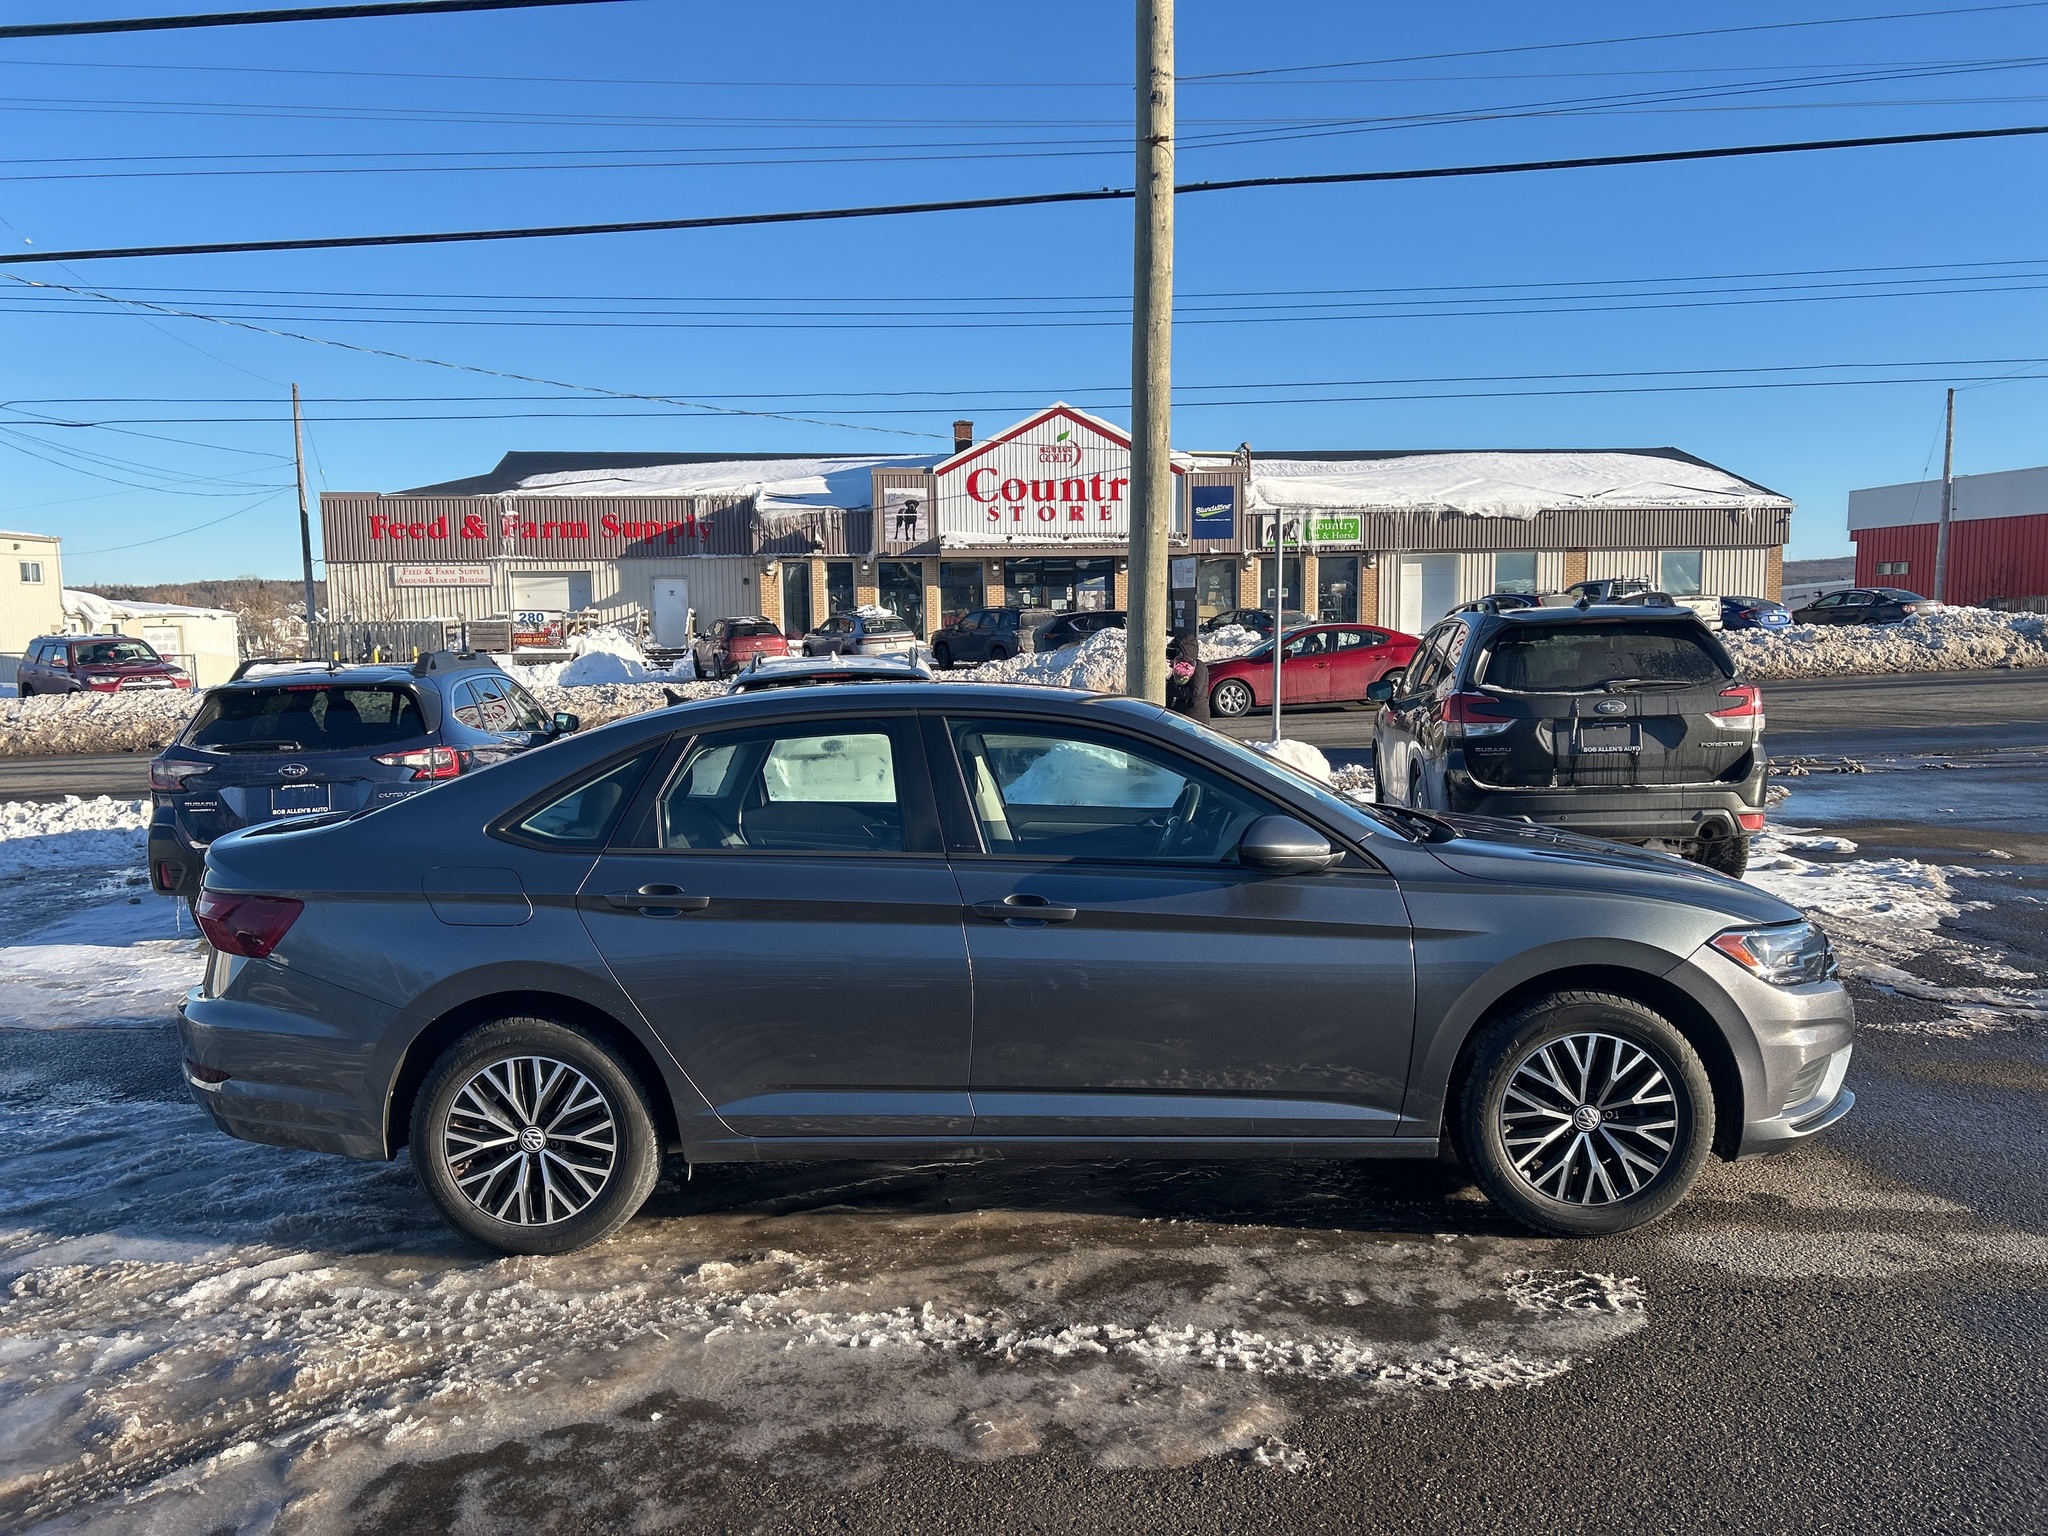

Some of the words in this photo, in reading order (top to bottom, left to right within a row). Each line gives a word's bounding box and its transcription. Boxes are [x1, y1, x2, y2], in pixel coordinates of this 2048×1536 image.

[1039, 453, 1072, 463] GOLD
[966, 467, 1131, 503] Countr
[987, 505, 1112, 522] STORE
[369, 515, 450, 540] Feed
[460, 514, 489, 540] &
[502, 512, 590, 539] Farm
[601, 513, 715, 545] Supply
[1322, 531, 1330, 540] &
[1331, 531, 1355, 539] Horse
[402, 567, 422, 575] FEED
[424, 567, 433, 575] &
[435, 567, 455, 575] FARM
[458, 567, 484, 575] SUPPLY
[397, 576, 427, 584] AROUND
[428, 576, 448, 584] REAR
[459, 576, 491, 584] BUILDING
[518, 612, 544, 624] 280
